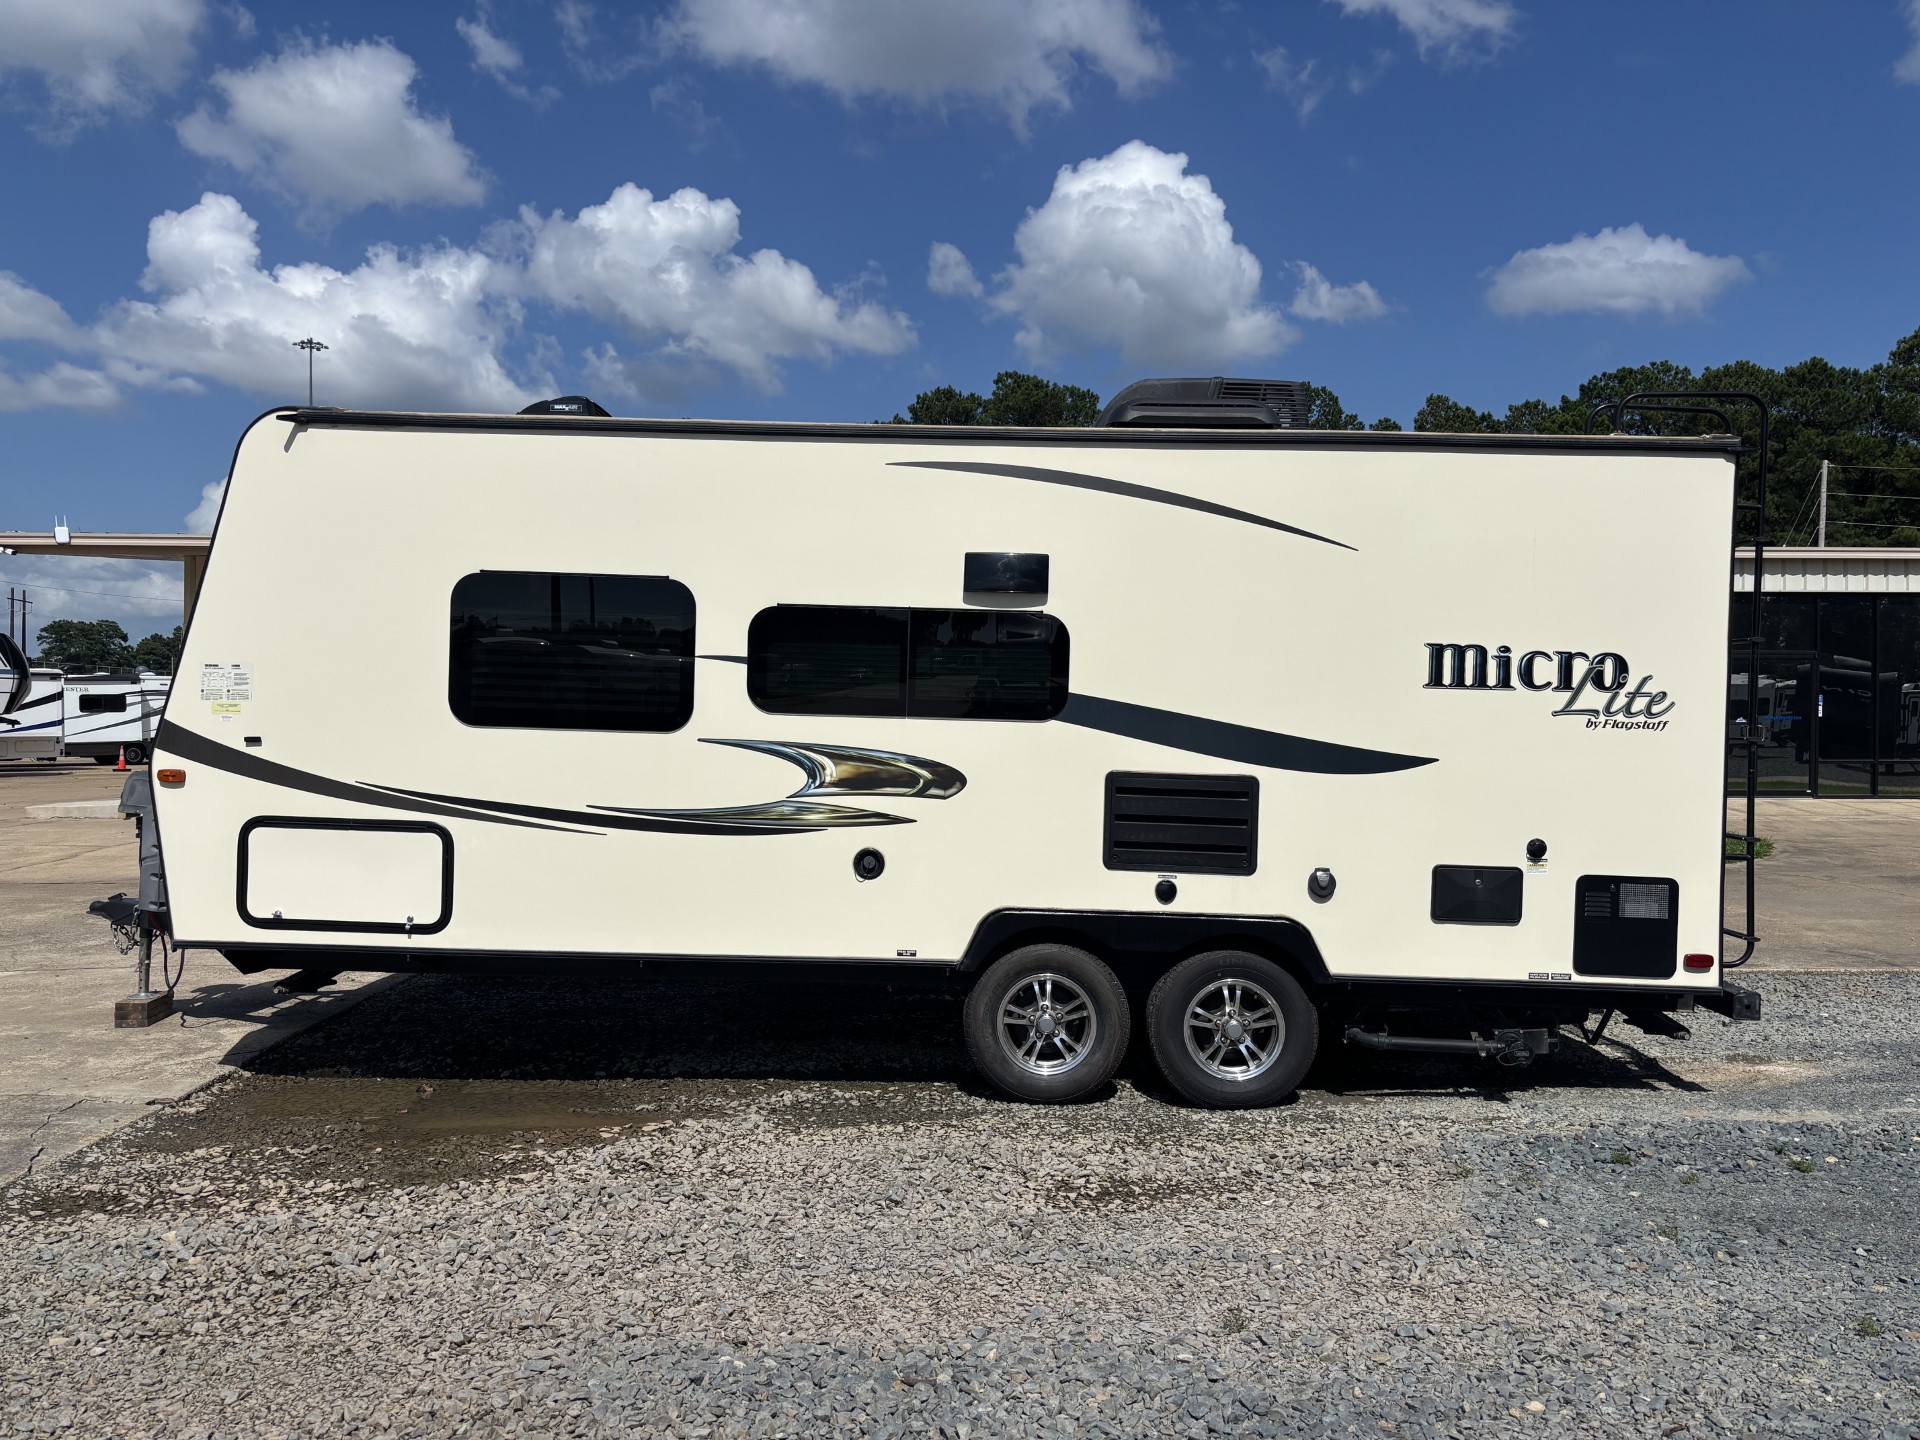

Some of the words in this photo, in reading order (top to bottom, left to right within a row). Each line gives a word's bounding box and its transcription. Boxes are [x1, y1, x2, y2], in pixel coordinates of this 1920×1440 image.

[1423, 642, 1629, 693] micro
[1551, 664, 1676, 719] Lite
[1585, 718, 1601, 730] by
[1602, 718, 1670, 731] Flagstaff
